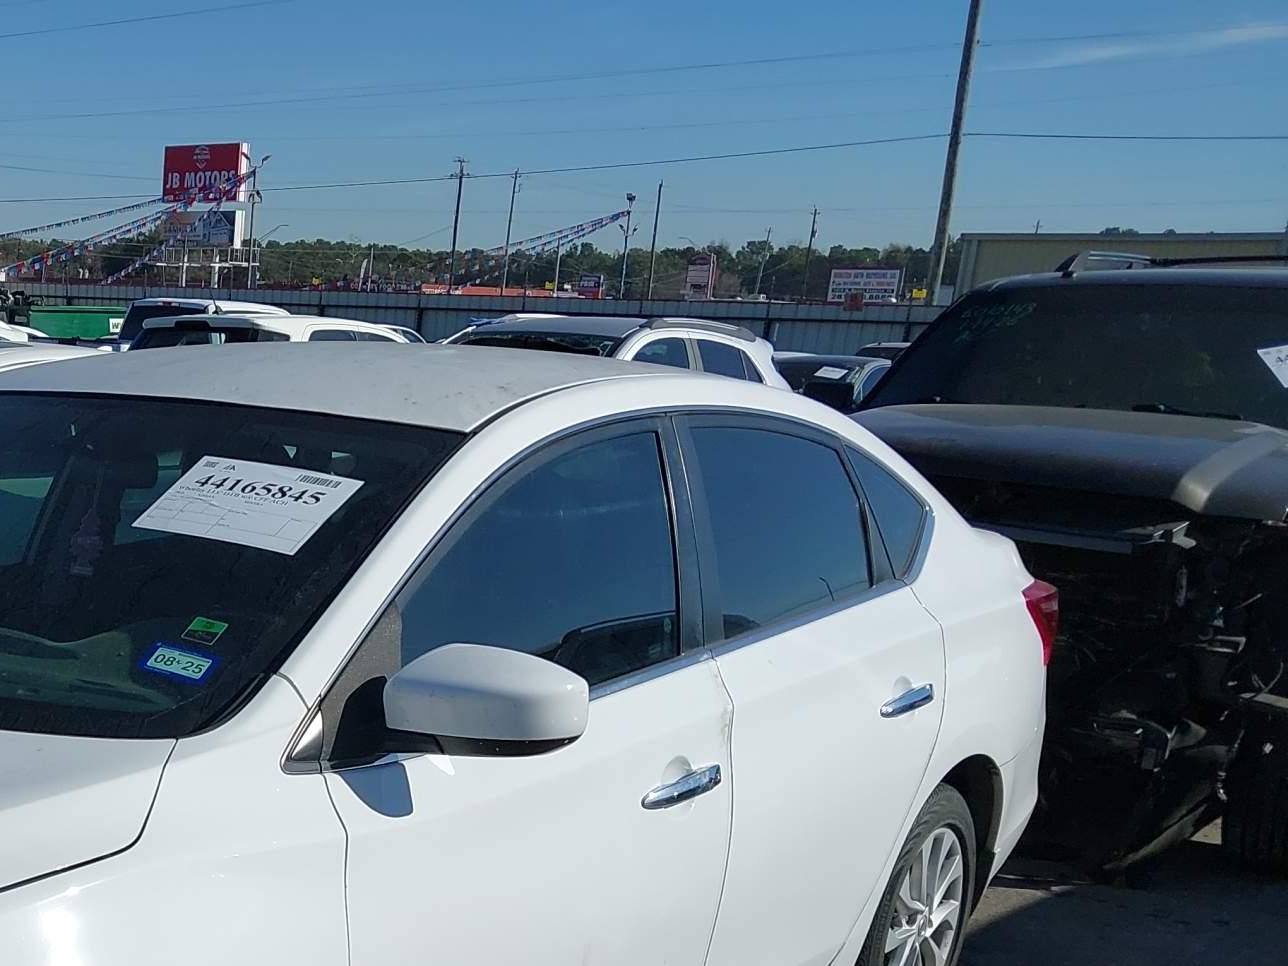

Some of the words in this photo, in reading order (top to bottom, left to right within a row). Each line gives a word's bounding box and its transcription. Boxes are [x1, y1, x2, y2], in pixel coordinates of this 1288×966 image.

[166, 172, 180, 188] JB
[184, 170, 236, 188] MOTORS
[195, 474, 328, 506] 44165845
